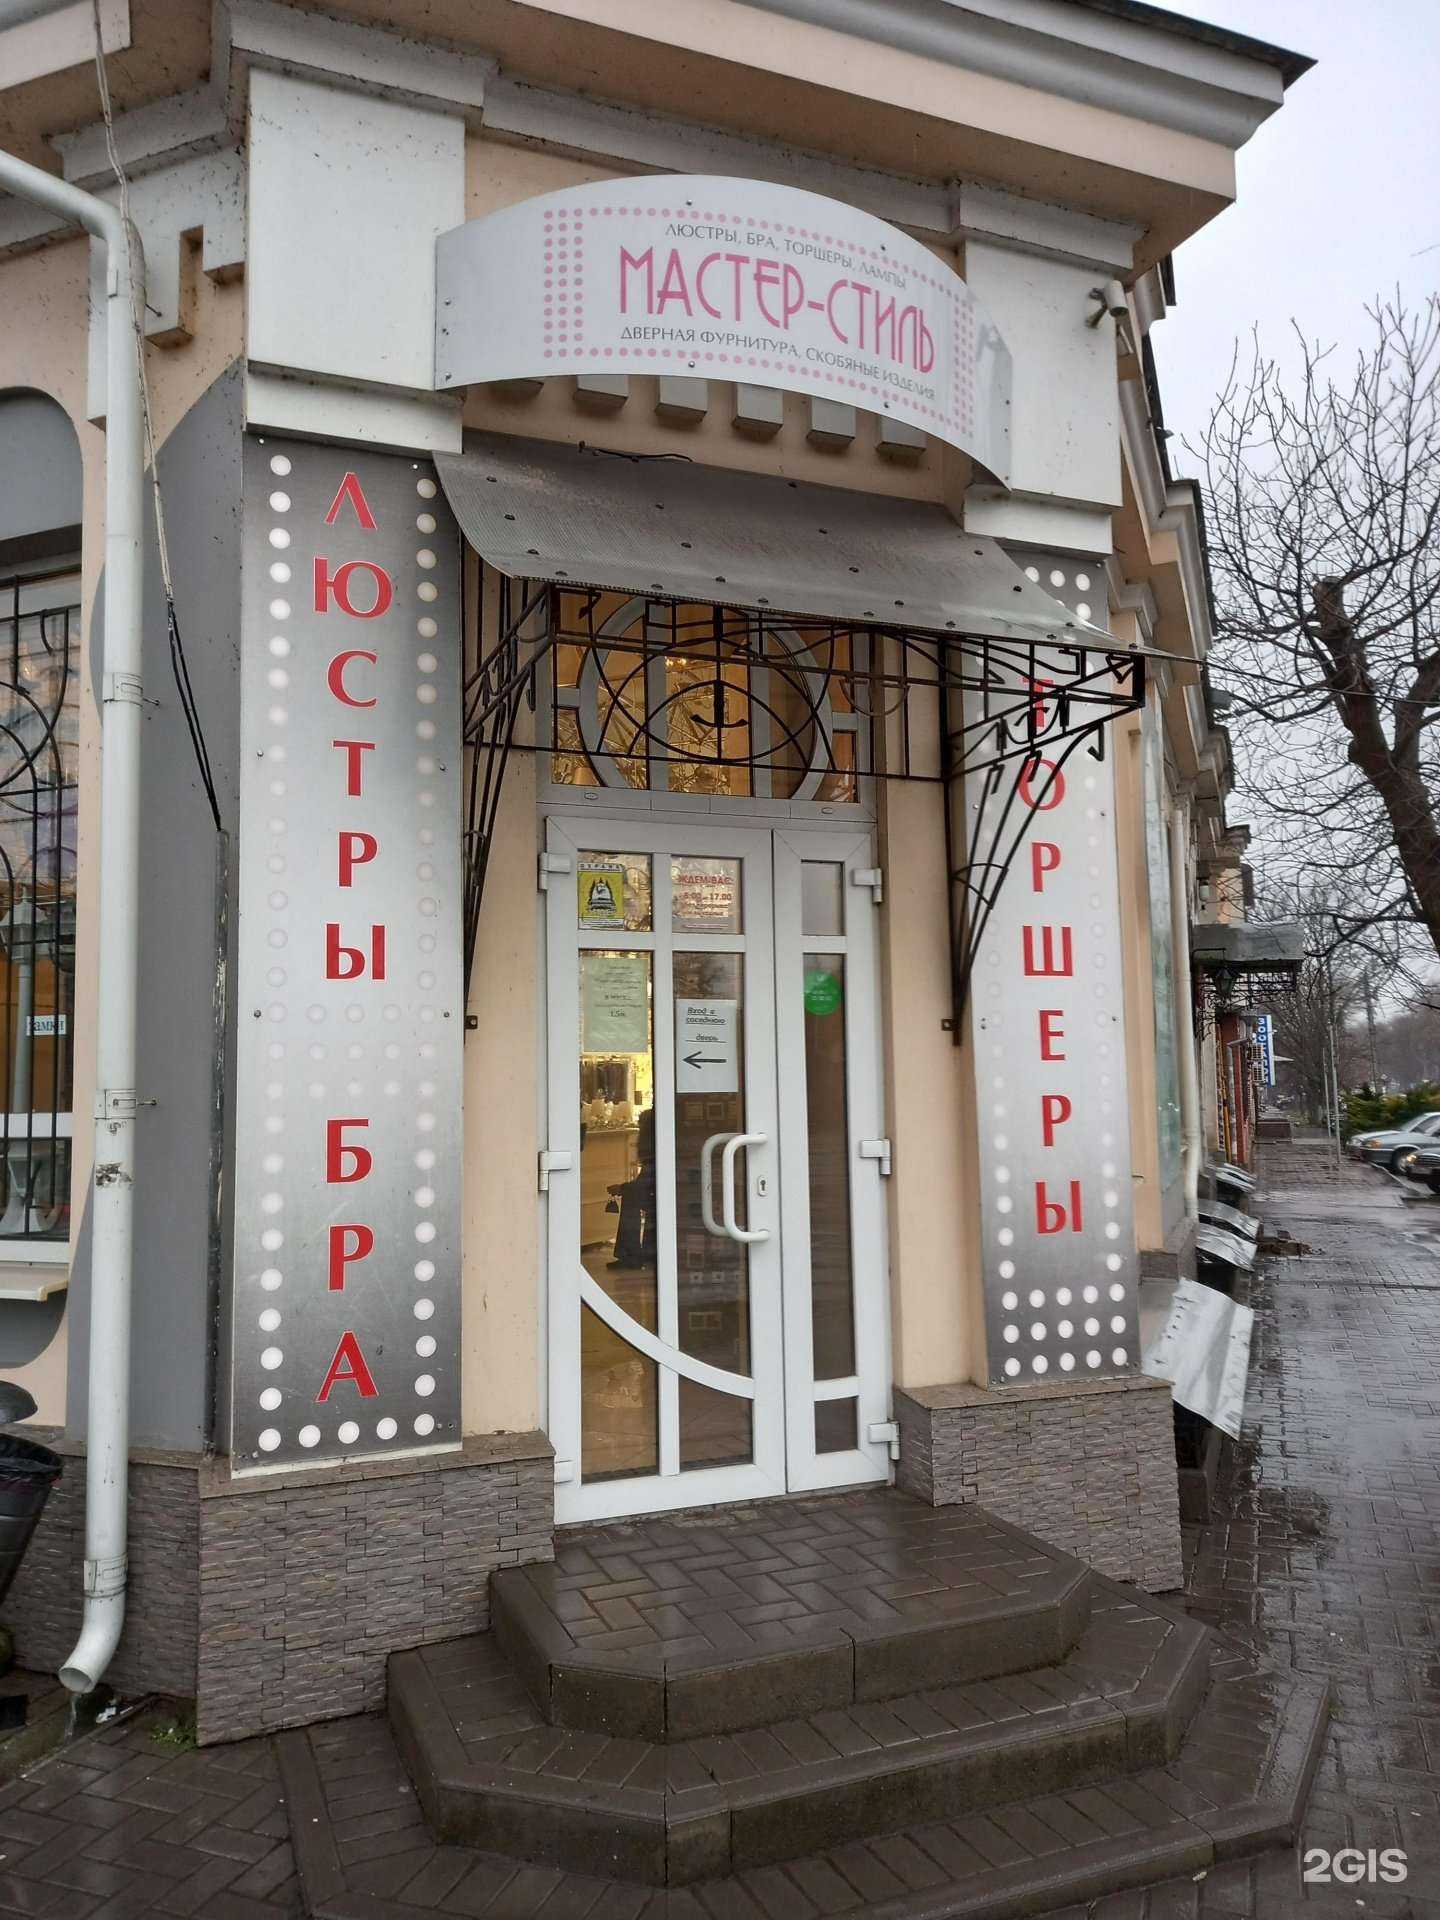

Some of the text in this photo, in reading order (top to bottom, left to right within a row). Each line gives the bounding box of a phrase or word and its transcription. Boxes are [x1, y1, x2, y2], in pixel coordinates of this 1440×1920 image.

[665, 223, 907, 290] ЛЮСТРЫ, БРА, ТОРШЕРЫ, ЛАМПЫ
[619, 245, 935, 374] МАСТЕР-СТИЛЬ
[620, 326, 936, 400] ДВЕРНАЯ ФУРНИТУРА, СКОБЯНЫЕ ИЗДЕЛИЯ
[313, 471, 393, 1403] ЛЮСТРЫ БРА
